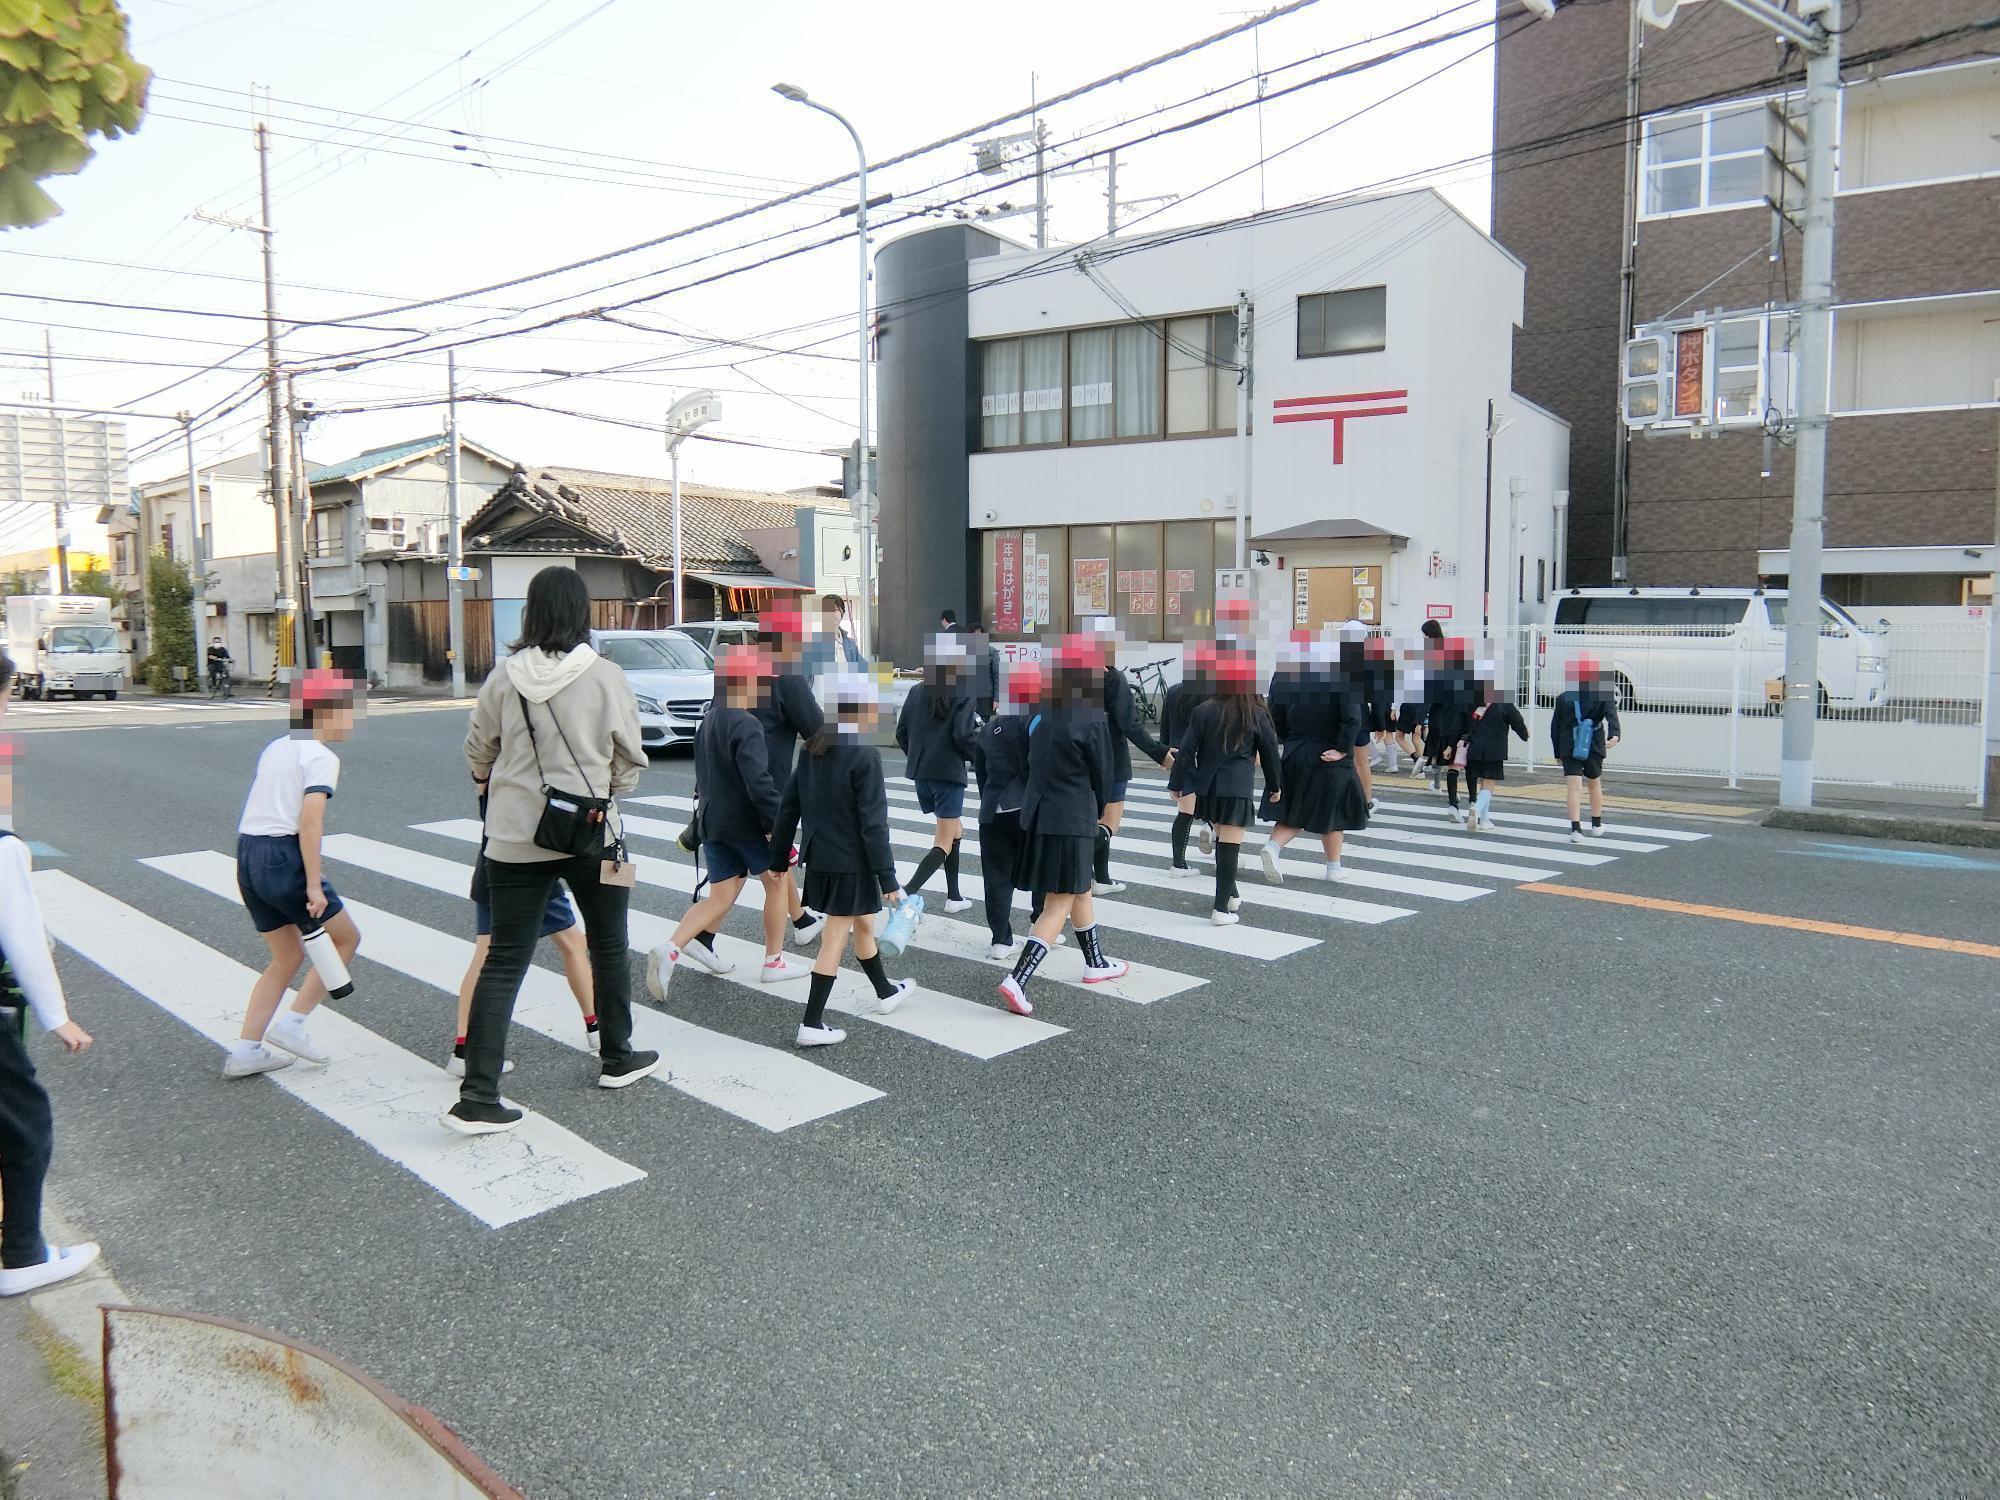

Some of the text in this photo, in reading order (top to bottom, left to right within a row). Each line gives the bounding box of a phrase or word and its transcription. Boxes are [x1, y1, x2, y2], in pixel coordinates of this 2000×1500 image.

[1003, 543, 1015, 614] 年賀はがき
[1024, 538, 1035, 617] 年賀はがき
